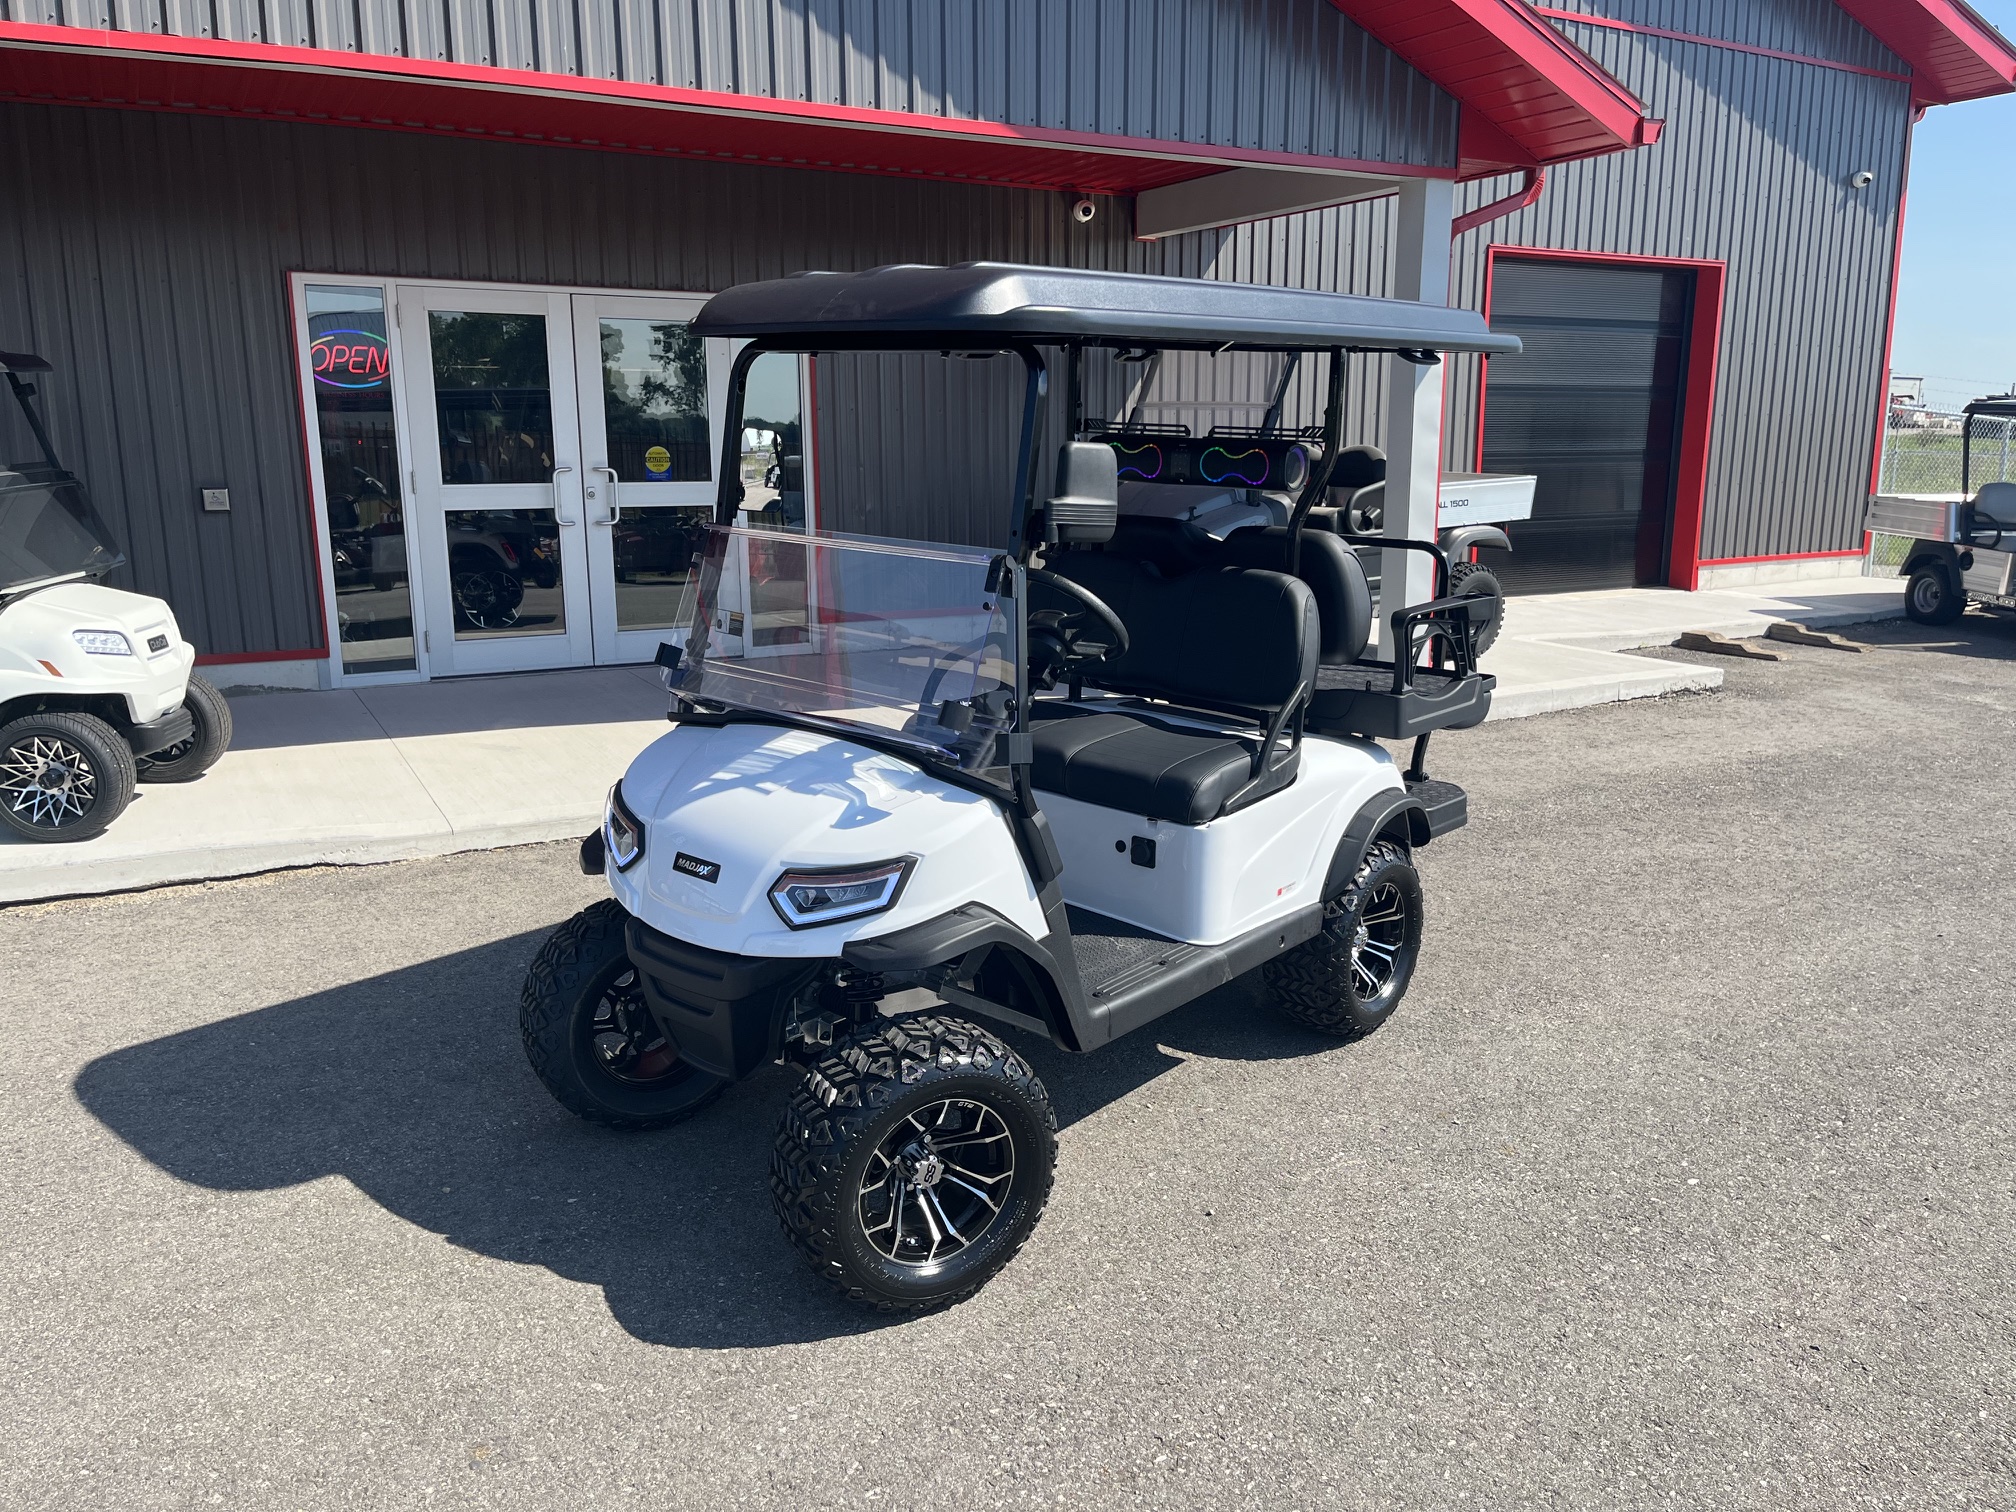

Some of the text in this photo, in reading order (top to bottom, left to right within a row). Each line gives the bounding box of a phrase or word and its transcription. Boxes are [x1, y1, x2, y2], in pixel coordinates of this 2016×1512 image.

[312, 344, 388, 373] OPEN
[1450, 499, 1469, 507] 1500
[1966, 590, 1998, 603] CARRYALL
[677, 858, 713, 875] MADJAX
